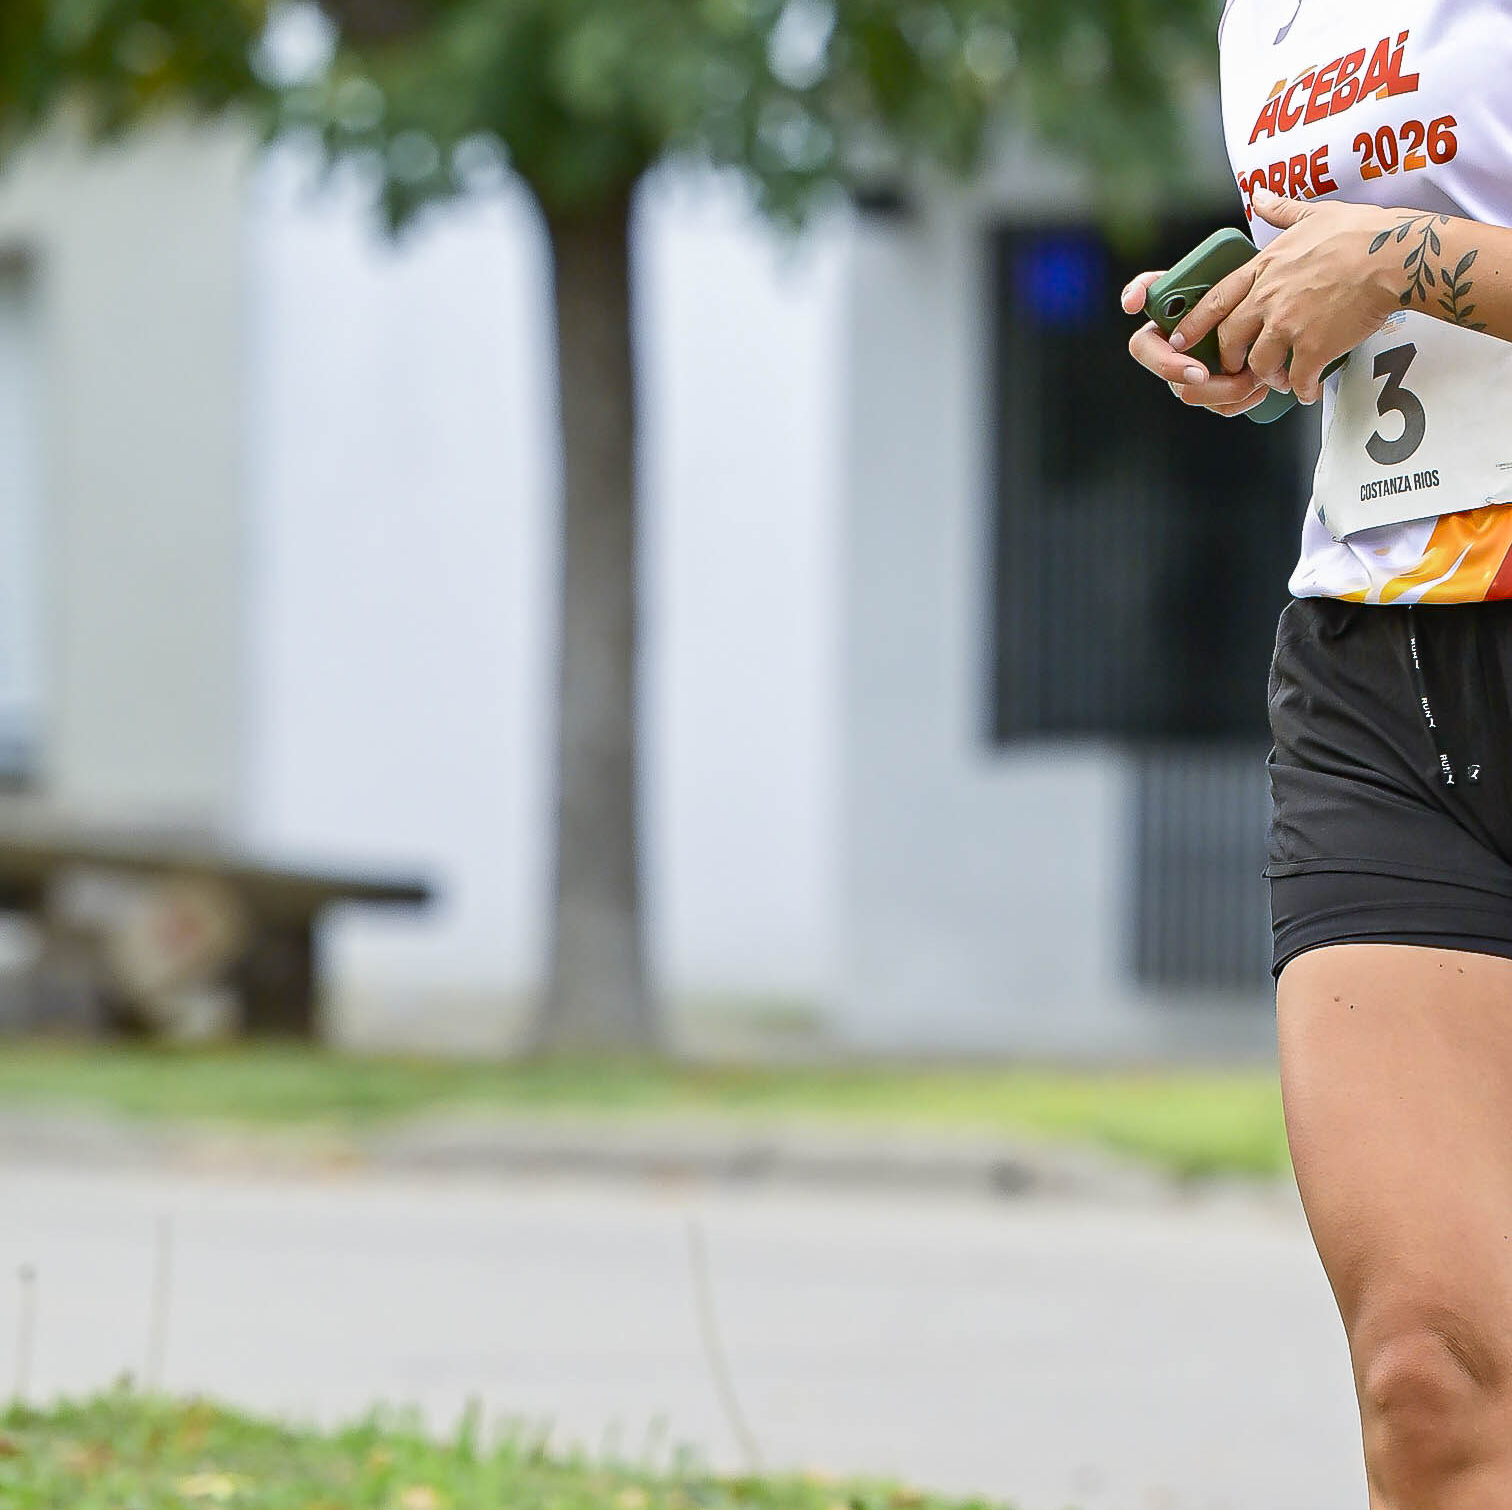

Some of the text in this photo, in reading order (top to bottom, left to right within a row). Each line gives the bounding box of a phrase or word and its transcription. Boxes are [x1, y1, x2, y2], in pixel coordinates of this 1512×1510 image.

[1248, 29, 1420, 146] ACEBAL
[1353, 114, 1458, 181] 2026
[1365, 342, 1426, 466] 3
[1360, 469, 1440, 502] COSTANZA RIOS
[1421, 697, 1433, 718] RUN
